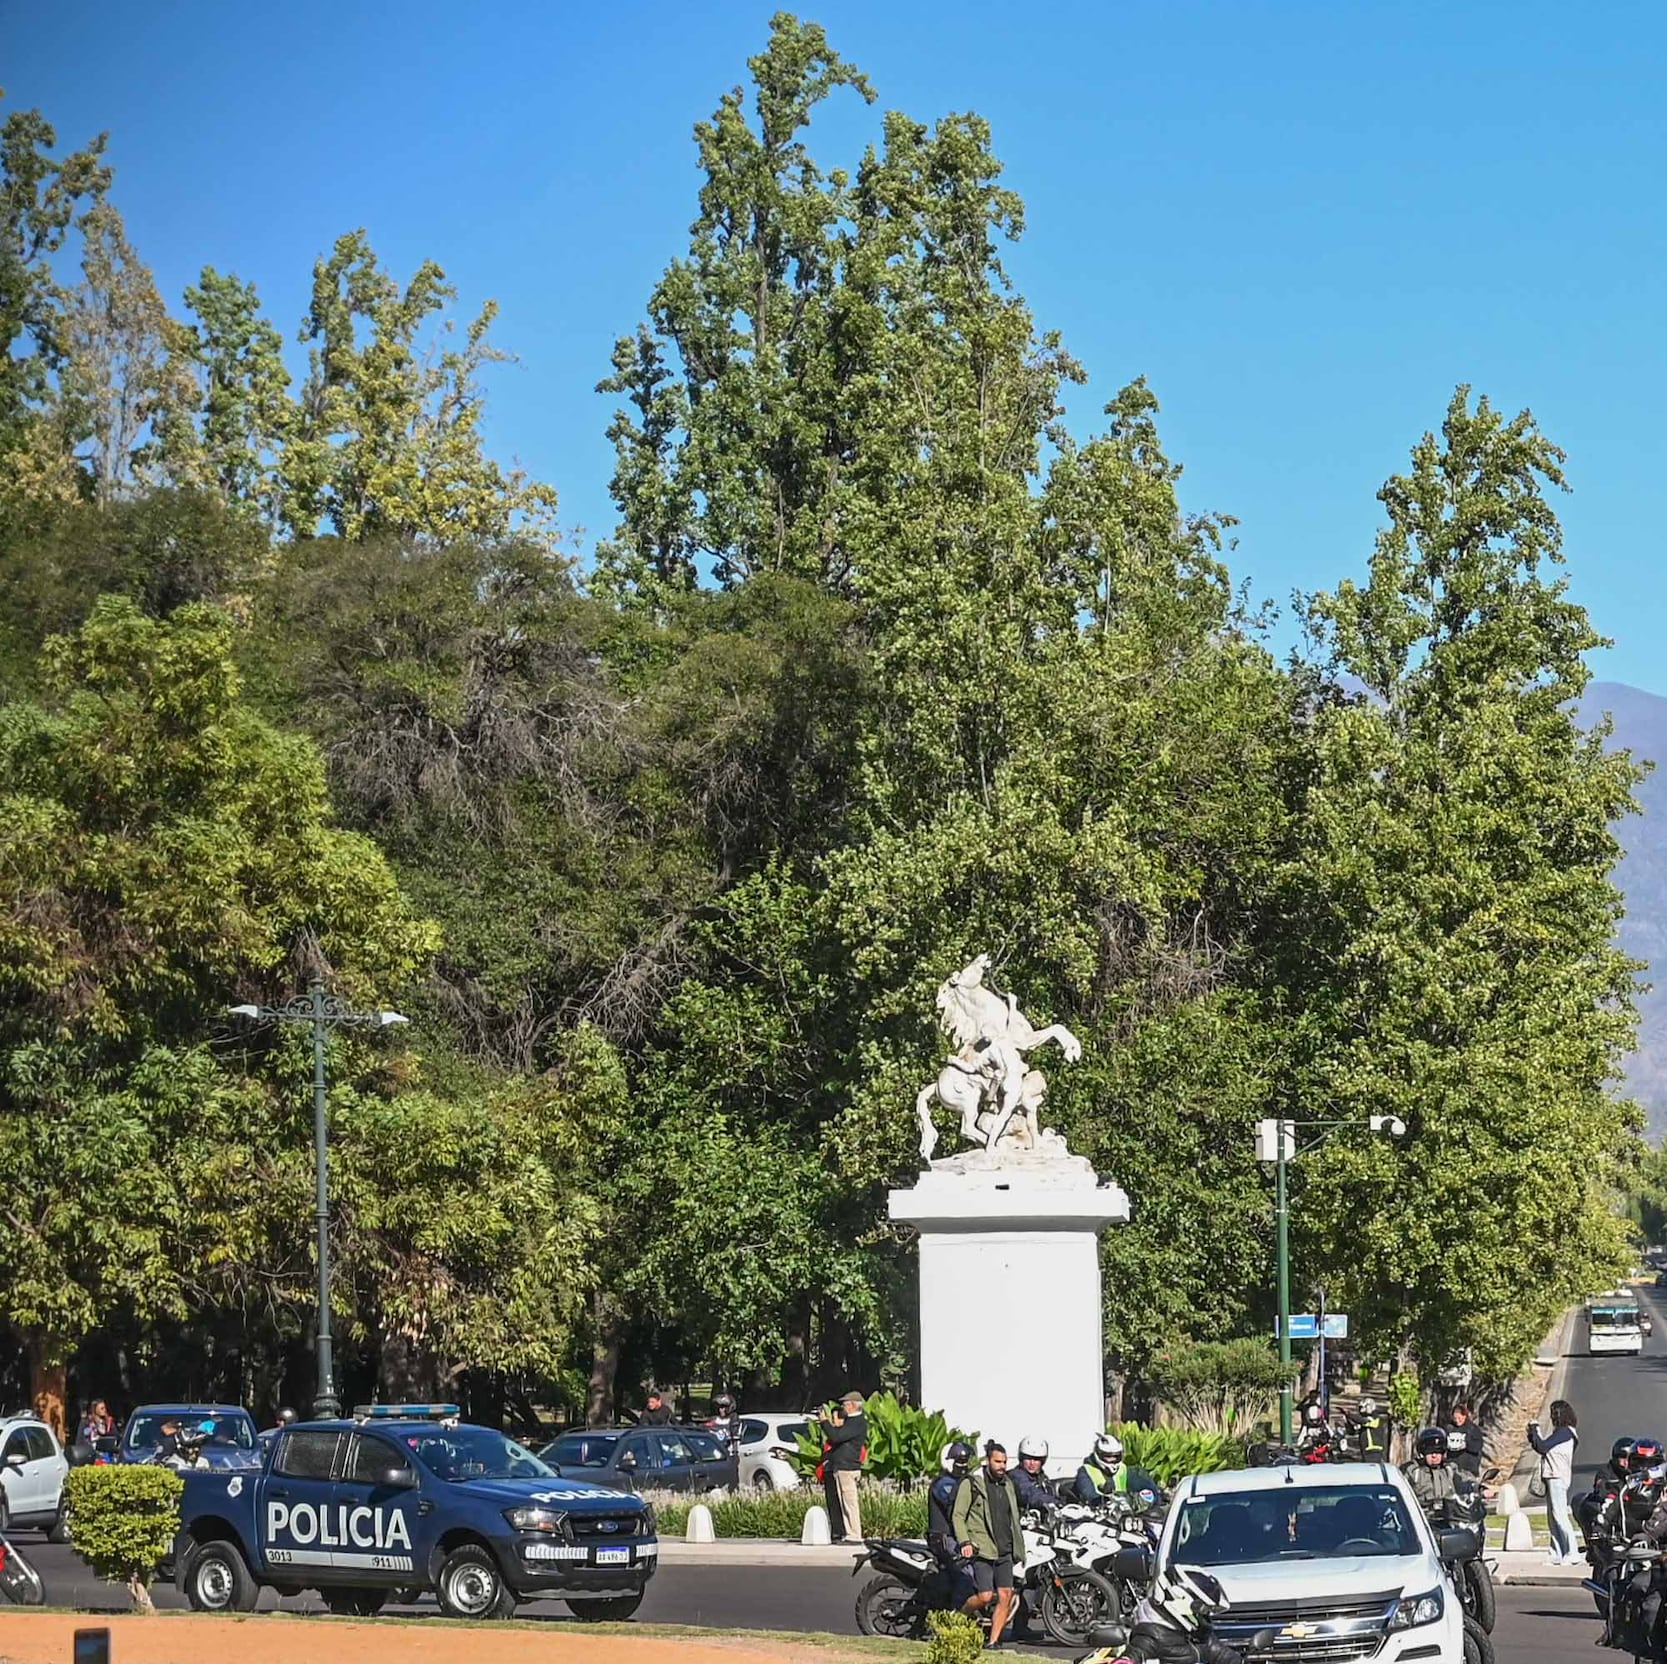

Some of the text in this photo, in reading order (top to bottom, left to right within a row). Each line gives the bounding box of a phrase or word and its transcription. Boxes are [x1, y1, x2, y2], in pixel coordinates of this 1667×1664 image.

[267, 1501, 413, 1551] POLICIA
[268, 1550, 293, 1563] 3013
[374, 1556, 392, 1568] 911
